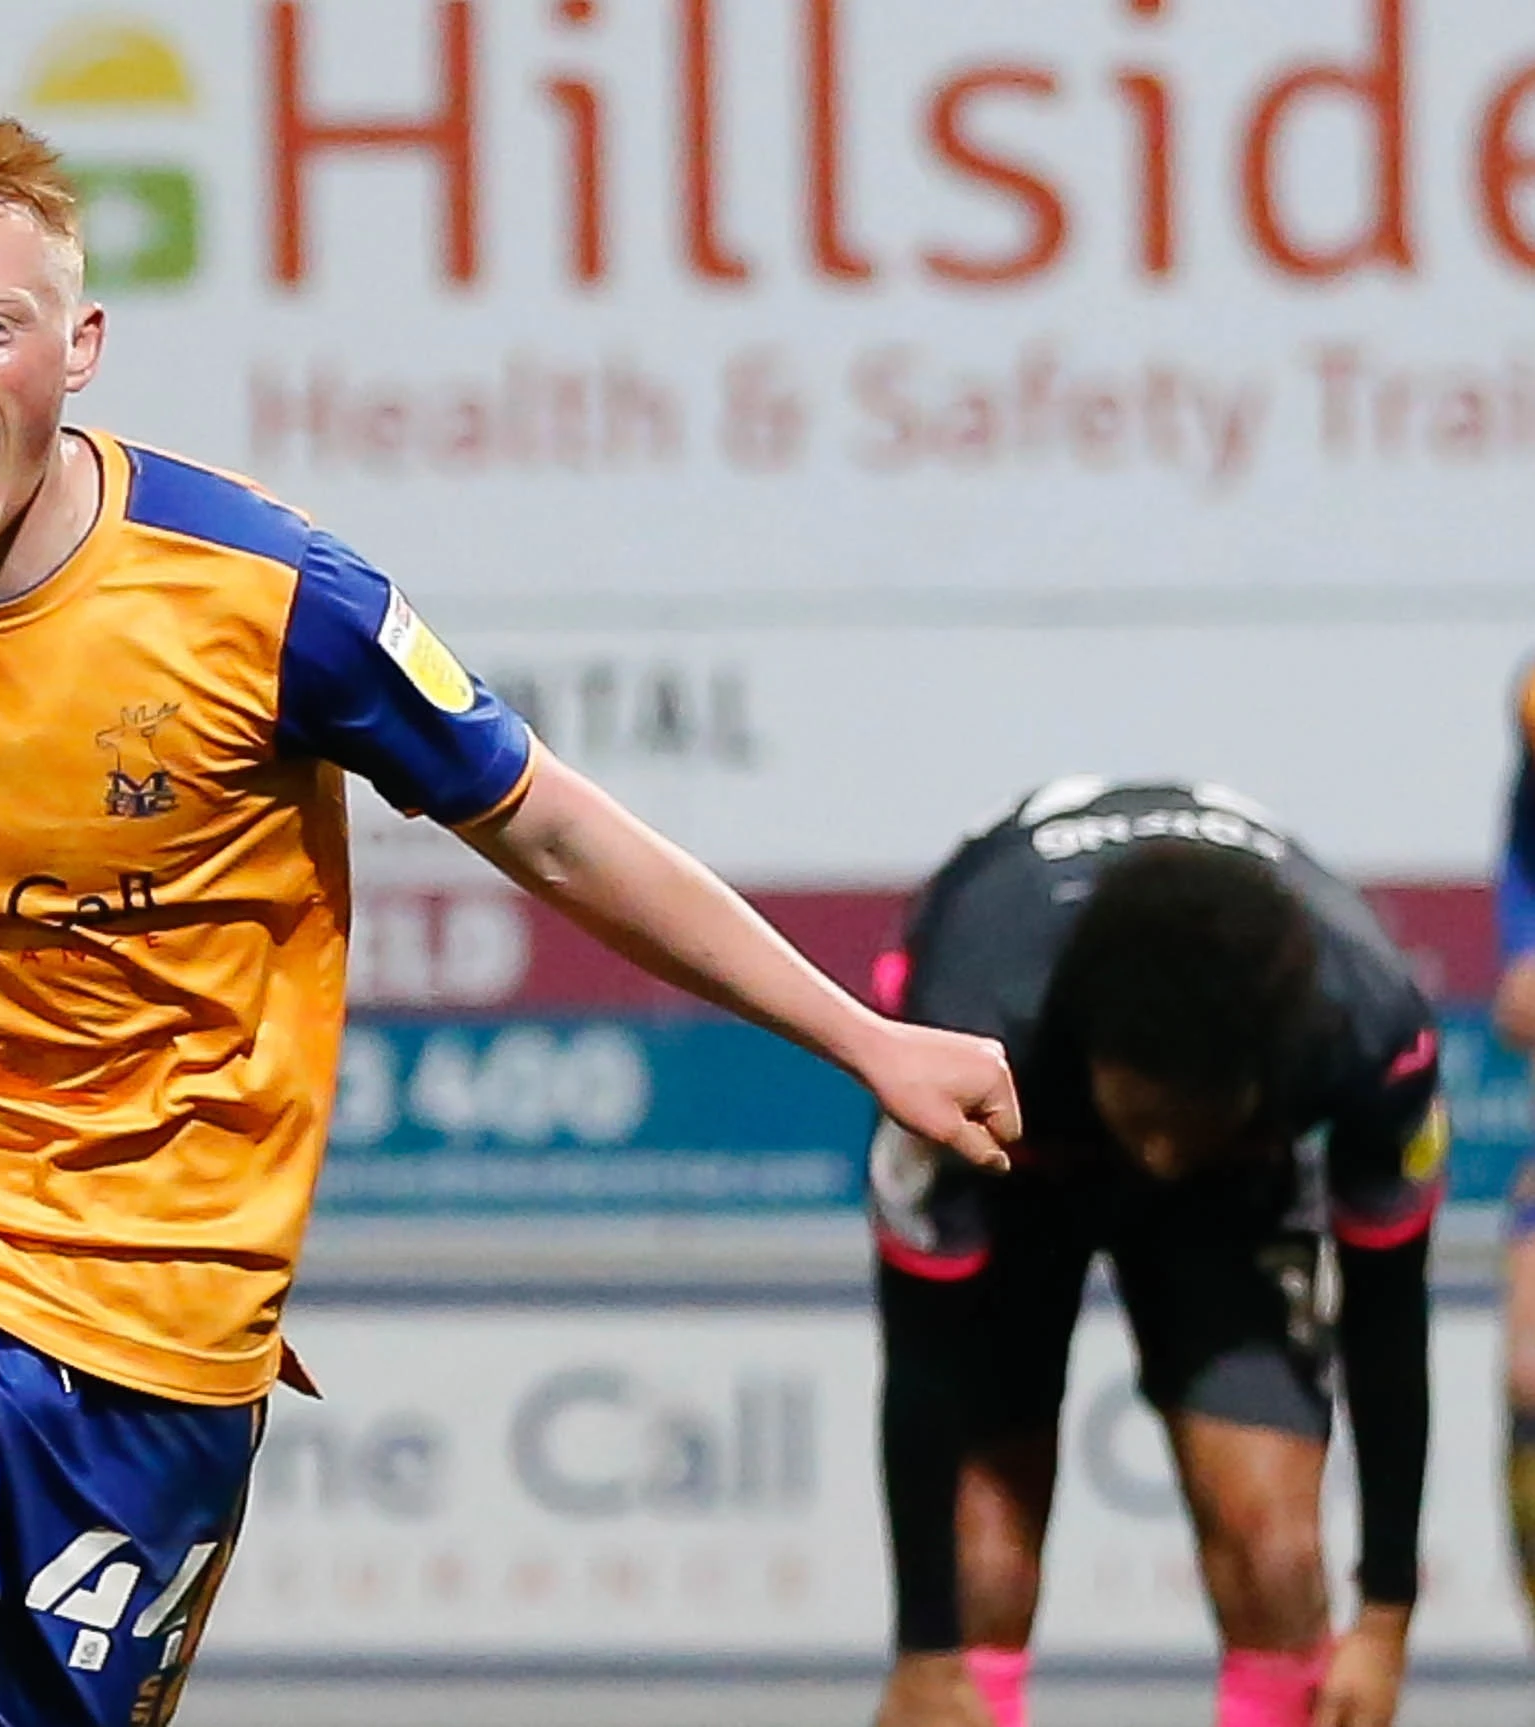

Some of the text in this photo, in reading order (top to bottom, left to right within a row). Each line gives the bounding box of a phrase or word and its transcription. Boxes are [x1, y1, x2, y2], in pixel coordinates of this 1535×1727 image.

[247, 343, 686, 472] Health
[848, 335, 1278, 500] Safety
[507, 1362, 821, 1521] Call
